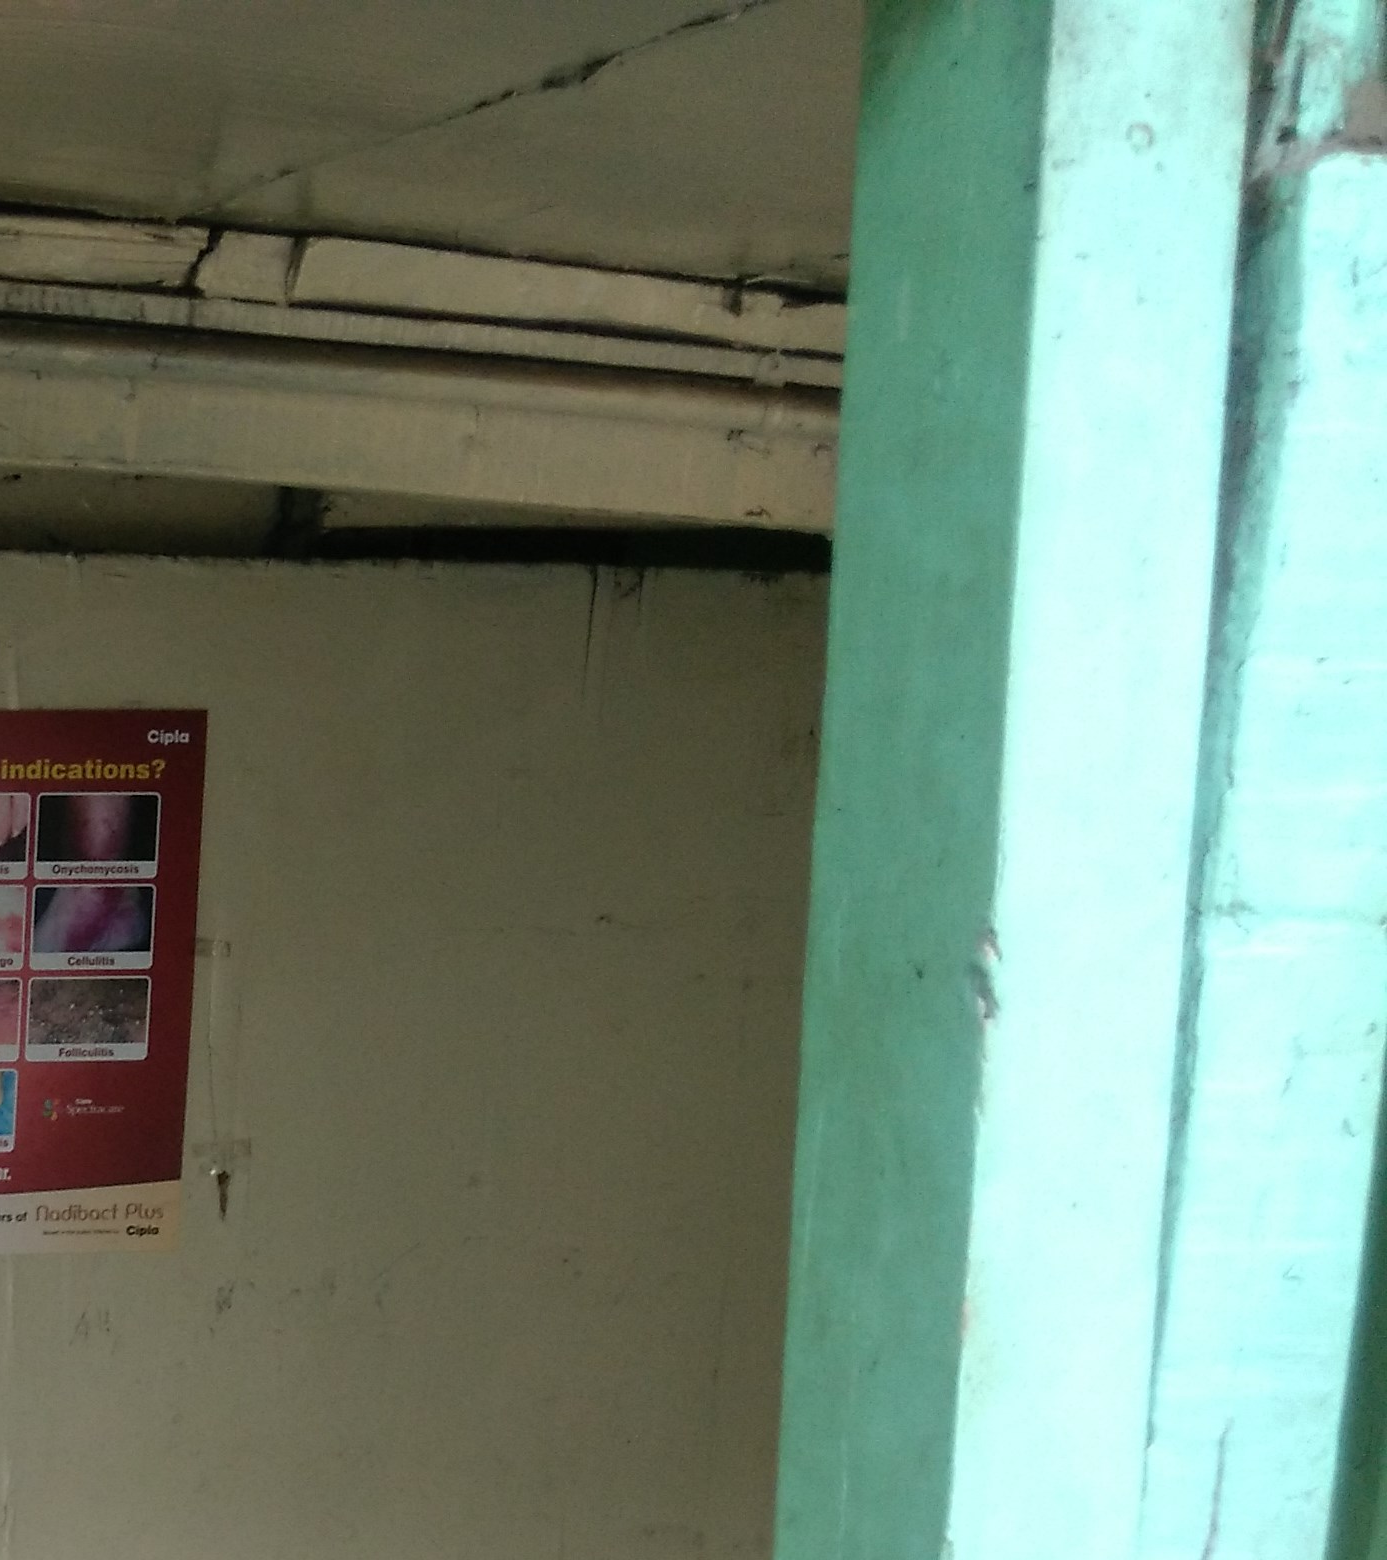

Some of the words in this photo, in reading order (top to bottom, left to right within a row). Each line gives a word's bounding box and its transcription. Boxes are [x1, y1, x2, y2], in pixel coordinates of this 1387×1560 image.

[146, 729, 191, 746] Cipla
[0, 757, 167, 781] indications?
[52, 863, 140, 876] Onychomycosis
[67, 955, 116, 967] Cellulitis
[14, 1210, 28, 1223] of
[124, 1202, 165, 1221] Plus
[126, 1224, 160, 1237] Cipla
